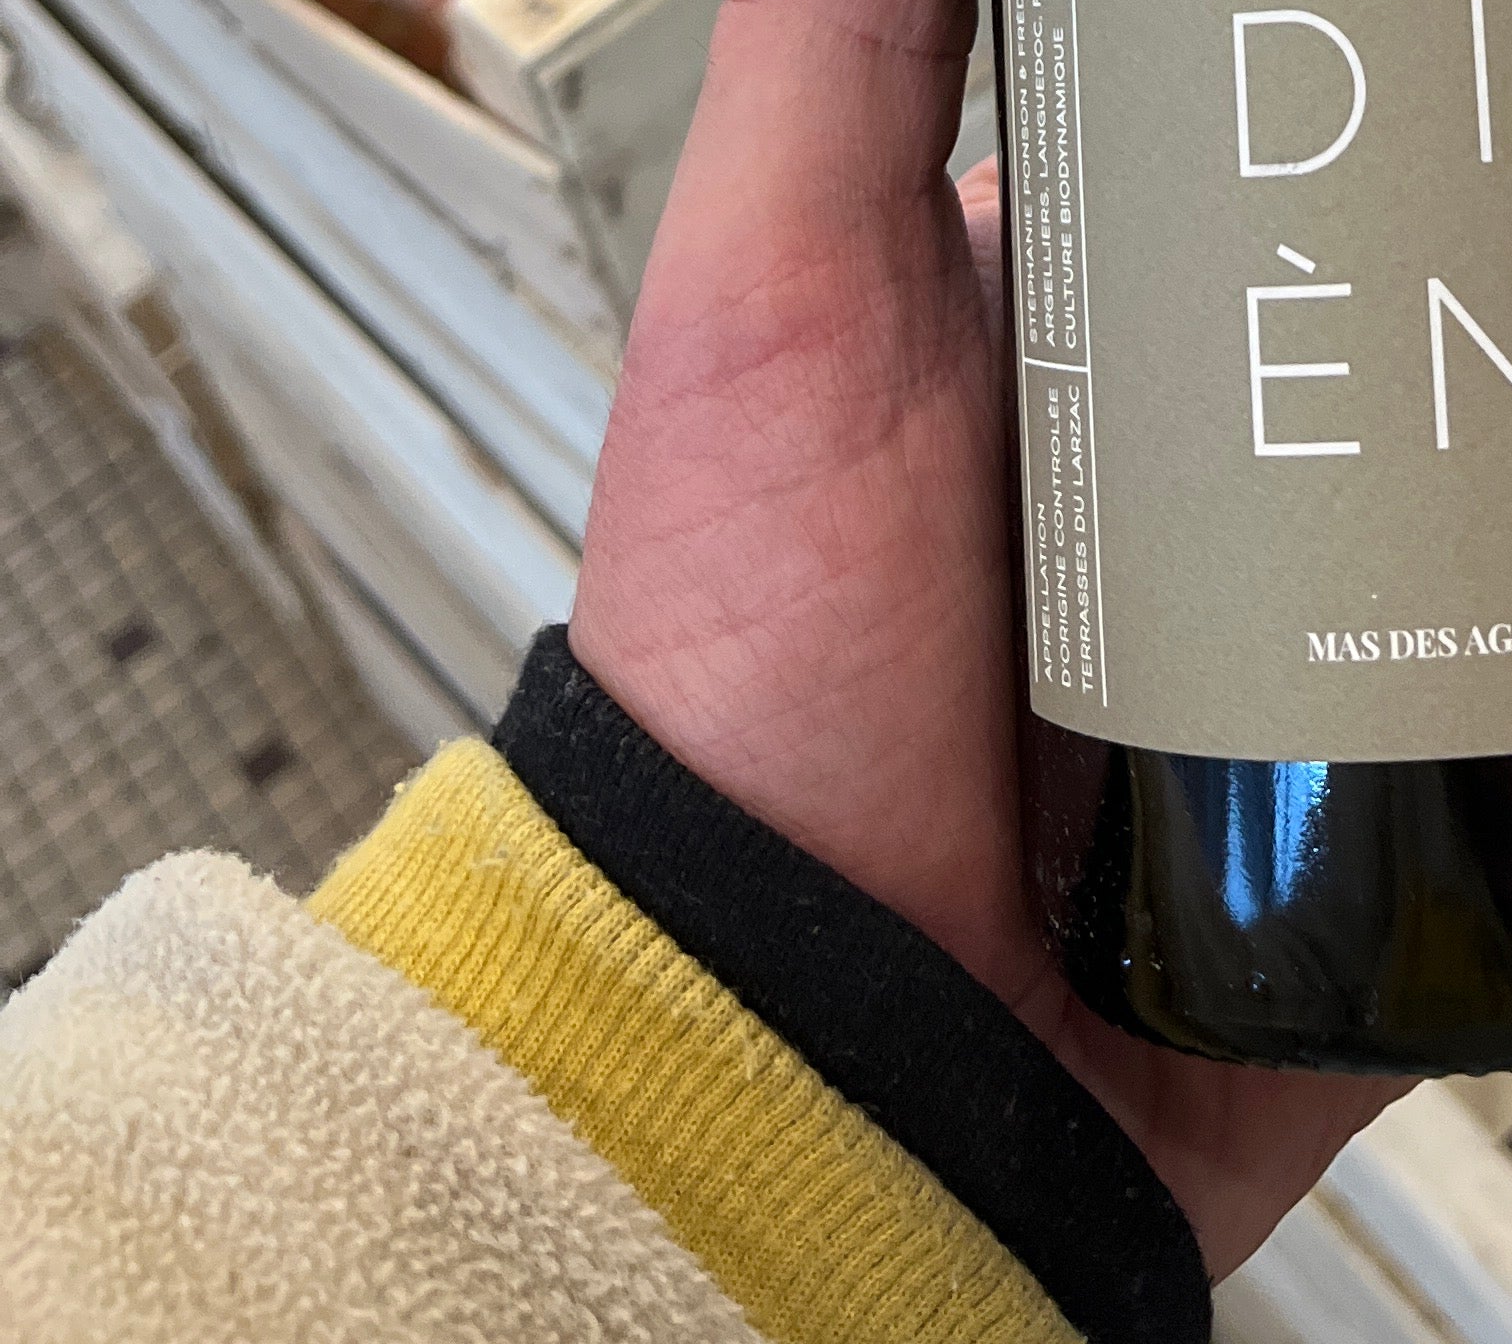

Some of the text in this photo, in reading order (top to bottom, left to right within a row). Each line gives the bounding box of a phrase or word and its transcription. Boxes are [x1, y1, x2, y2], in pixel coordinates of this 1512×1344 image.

[1019, 65, 1028, 80] &
[1019, 88, 1032, 195] PONSON
[1052, 27, 1077, 349] CULTURE BIODYNAMIQUE
[1037, 502, 1053, 682] APPELLATION
[1048, 386, 1072, 688] D'ORIGINE CONTROLÉE
[1068, 384, 1094, 693] TERRASSES DU LARZAC
[1307, 630, 1381, 663] MAS
[1389, 626, 1459, 660] DES
